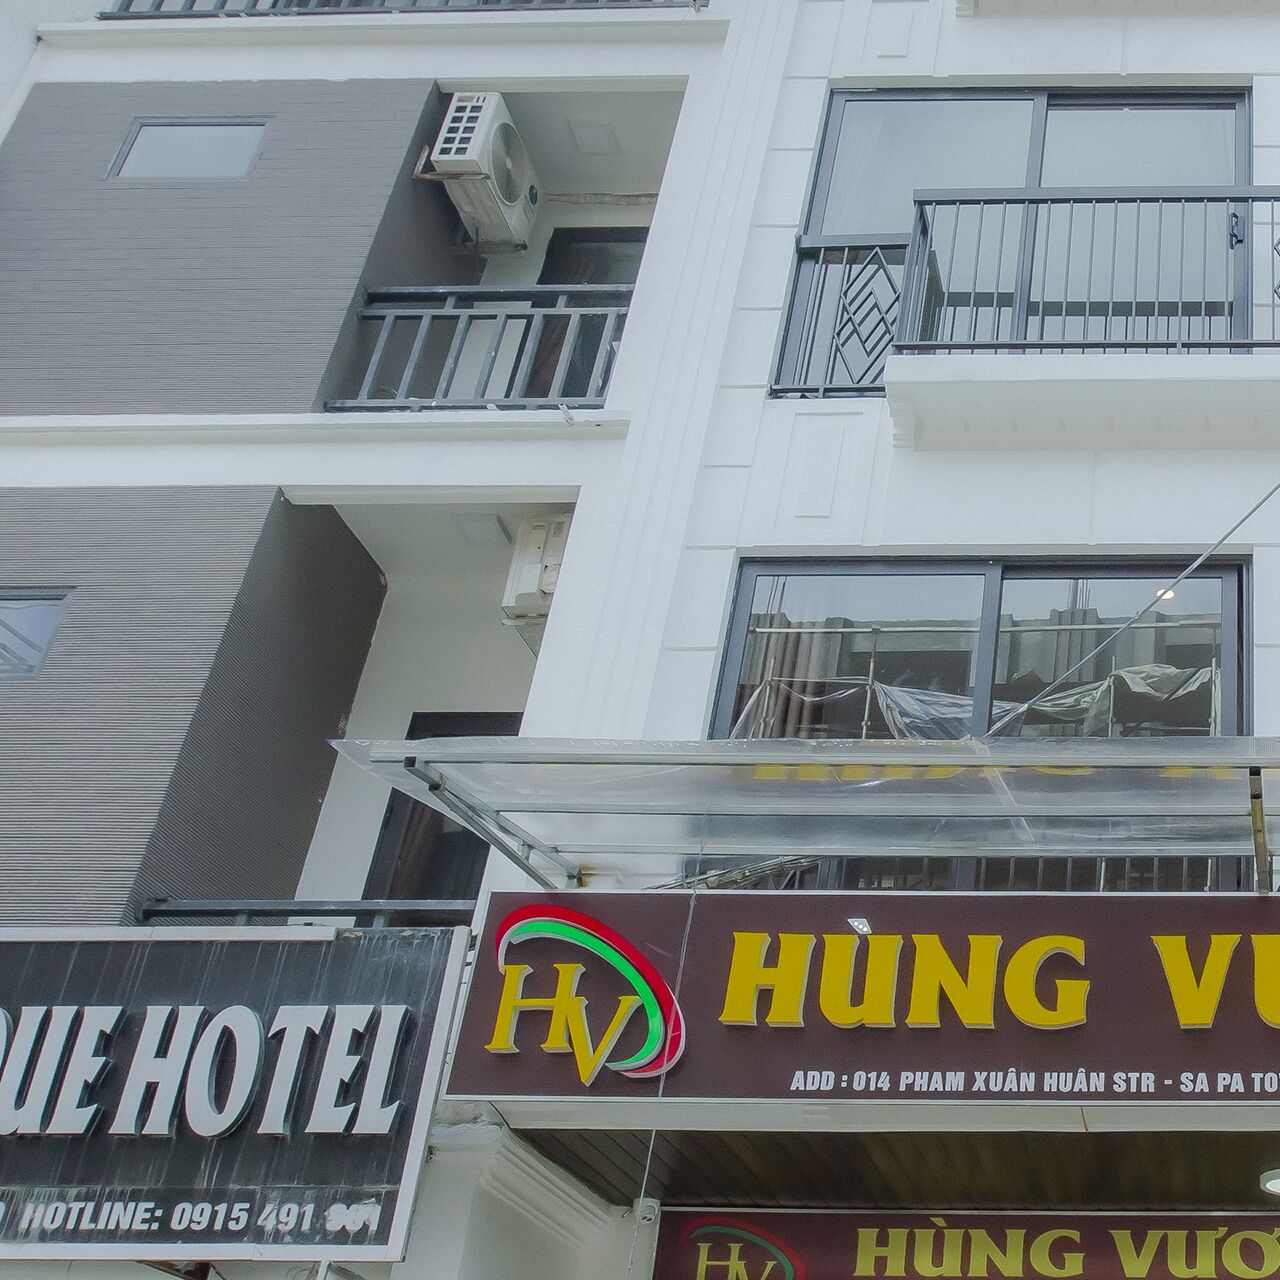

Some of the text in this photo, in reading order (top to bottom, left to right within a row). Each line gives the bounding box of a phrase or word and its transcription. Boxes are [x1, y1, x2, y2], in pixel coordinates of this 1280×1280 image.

[719, 918, 1091, 1029] HÙNG
[0, 1005, 410, 1138] UE HOTEL
[853, 1071, 891, 1091] 014
[972, 1067, 1037, 1092] XUÂN
[1043, 1067, 1105, 1093] HUÂN
[1112, 1072, 1155, 1093] STR
[1180, 1072, 1209, 1093] SA
[1217, 1072, 1245, 1093] PA
[19, 1201, 163, 1232] HOTLINE:
[170, 1202, 250, 1231] 0915
[257, 1202, 315, 1232] 491
[853, 1217, 1086, 1279] HÙNG
